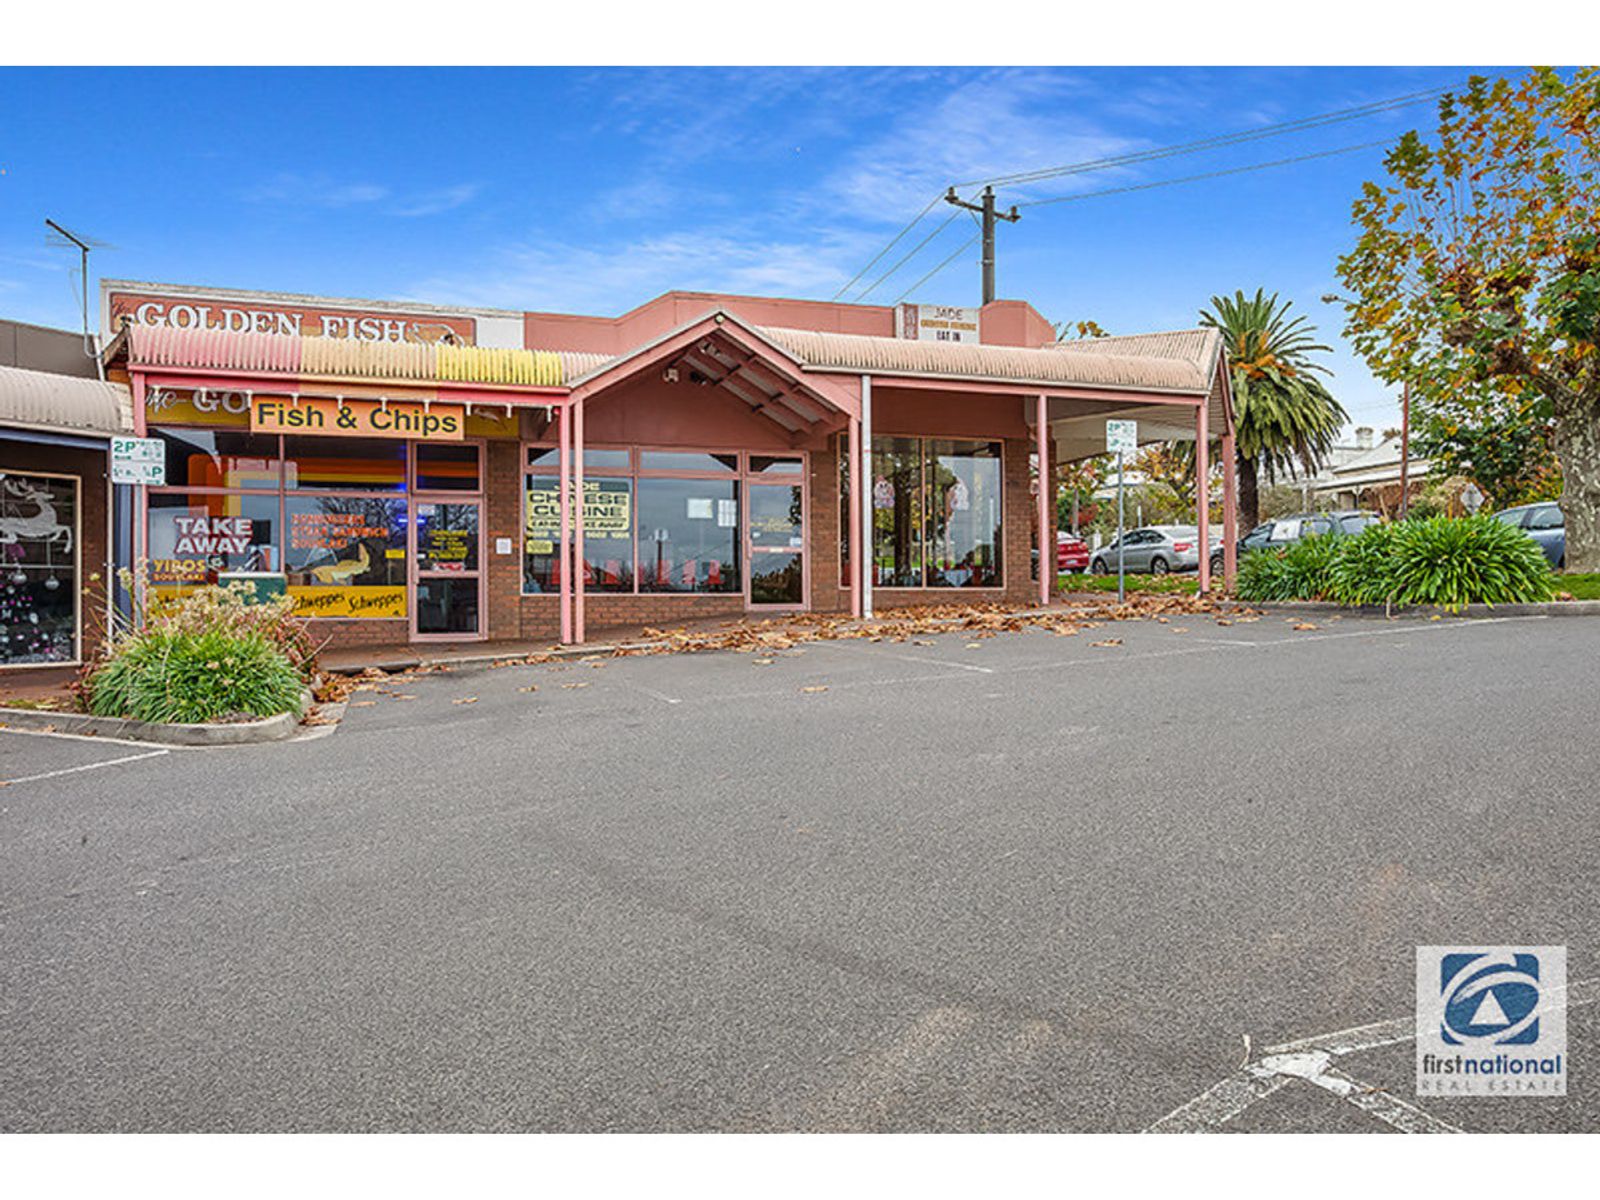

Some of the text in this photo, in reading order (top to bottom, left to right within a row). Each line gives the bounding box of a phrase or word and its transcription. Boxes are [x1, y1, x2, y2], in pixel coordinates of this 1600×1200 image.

[136, 302, 410, 343] GOLDEN FISH
[934, 307, 963, 320] JADE
[257, 402, 458, 437] Fish & Chips
[114, 440, 136, 452] 2P
[174, 516, 252, 536] TAKE
[174, 535, 252, 555] AWAY
